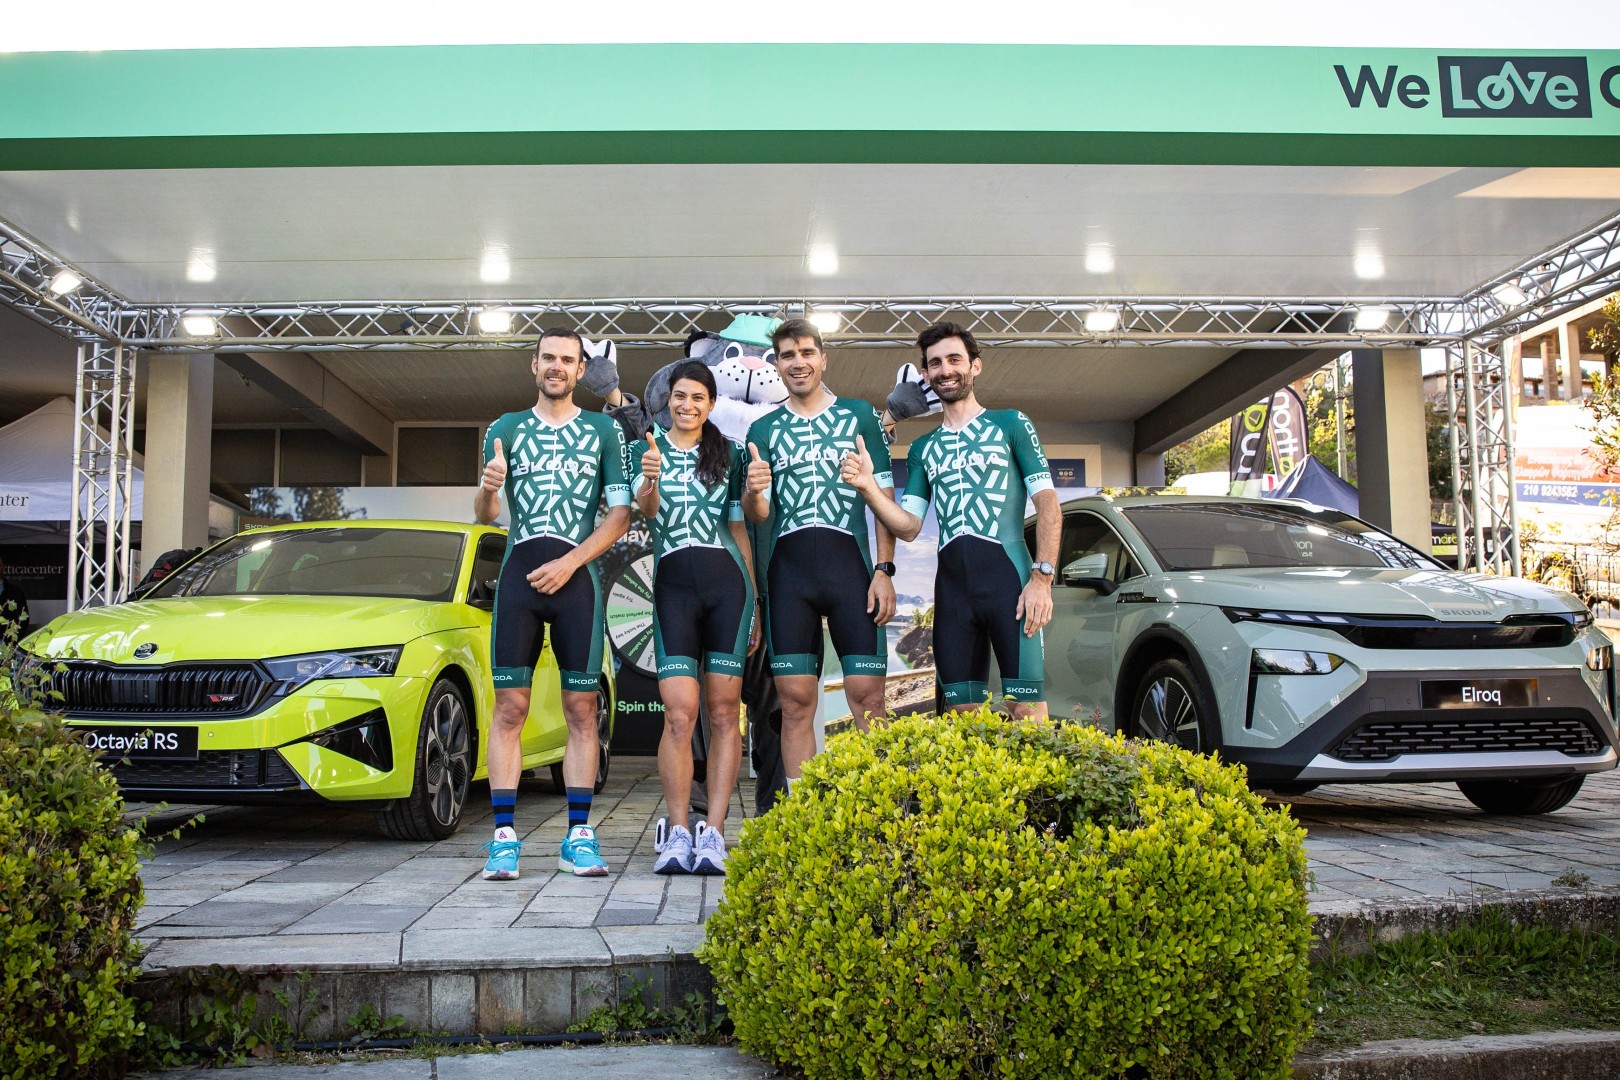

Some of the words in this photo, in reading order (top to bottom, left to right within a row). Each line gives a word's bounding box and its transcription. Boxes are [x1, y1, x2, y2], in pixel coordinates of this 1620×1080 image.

[1333, 65, 1430, 108] We
[1017, 410, 1049, 468] SKODA
[613, 419, 629, 480] SKODA
[1522, 484, 1539, 496] 210
[658, 663, 690, 674] SKODA
[710, 658, 742, 668] SKODA
[1462, 686, 1502, 706] Elroq
[617, 700, 645, 714] Spin
[647, 701, 666, 712] the
[83, 732, 149, 750] Octavia
[154, 732, 179, 750] RS
